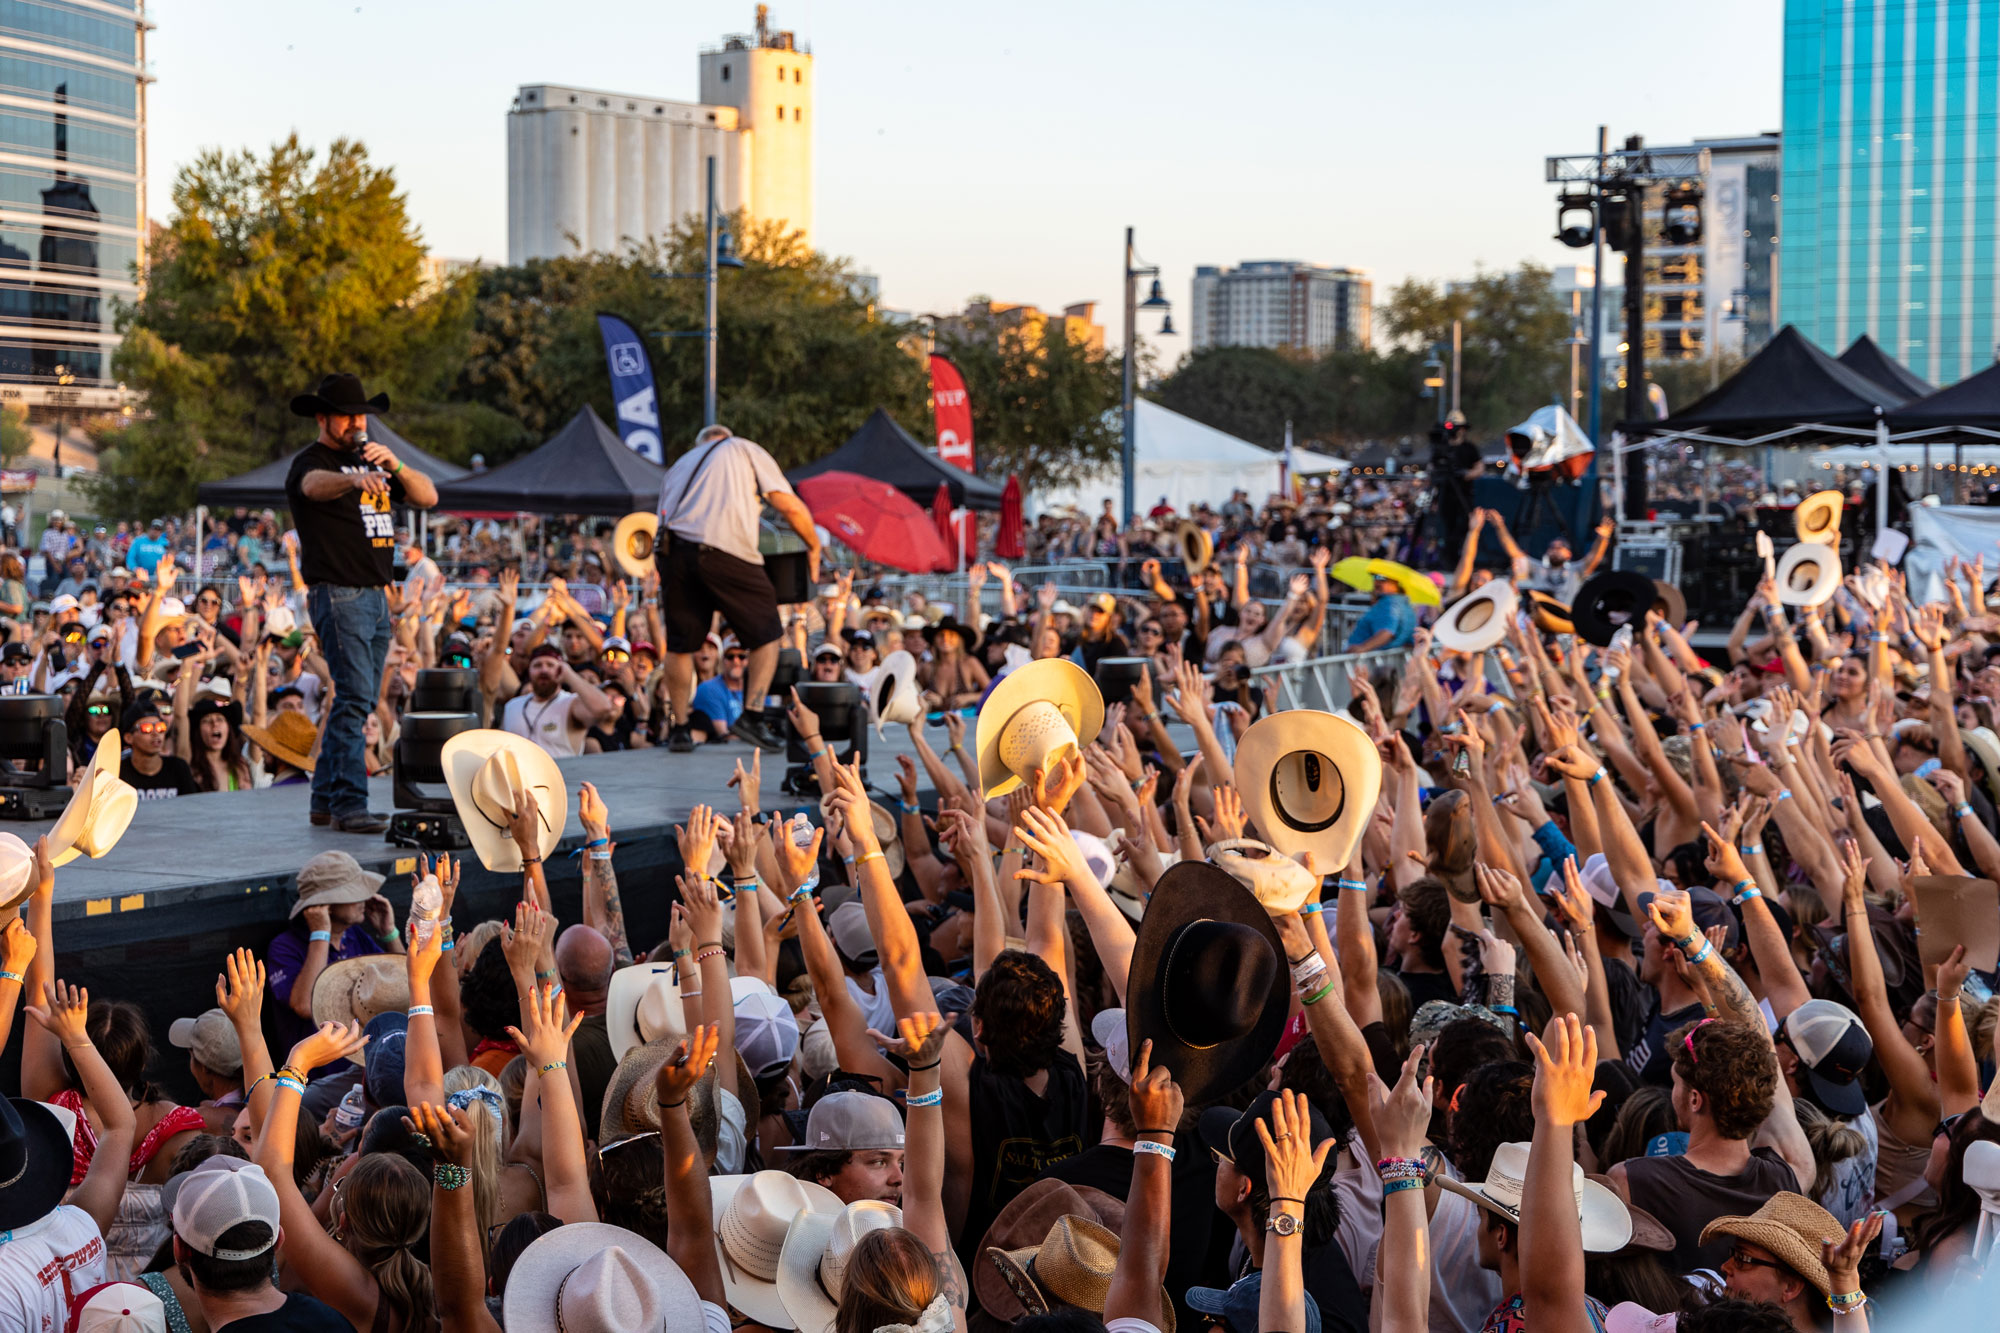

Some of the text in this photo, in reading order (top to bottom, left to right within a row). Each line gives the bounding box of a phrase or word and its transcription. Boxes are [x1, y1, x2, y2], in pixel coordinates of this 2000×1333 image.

[936, 389, 966, 407] VIP
[617, 386, 663, 465] DA
[1654, 1136, 1668, 1156] io
[1391, 1179, 1416, 1189] 2-DAY
